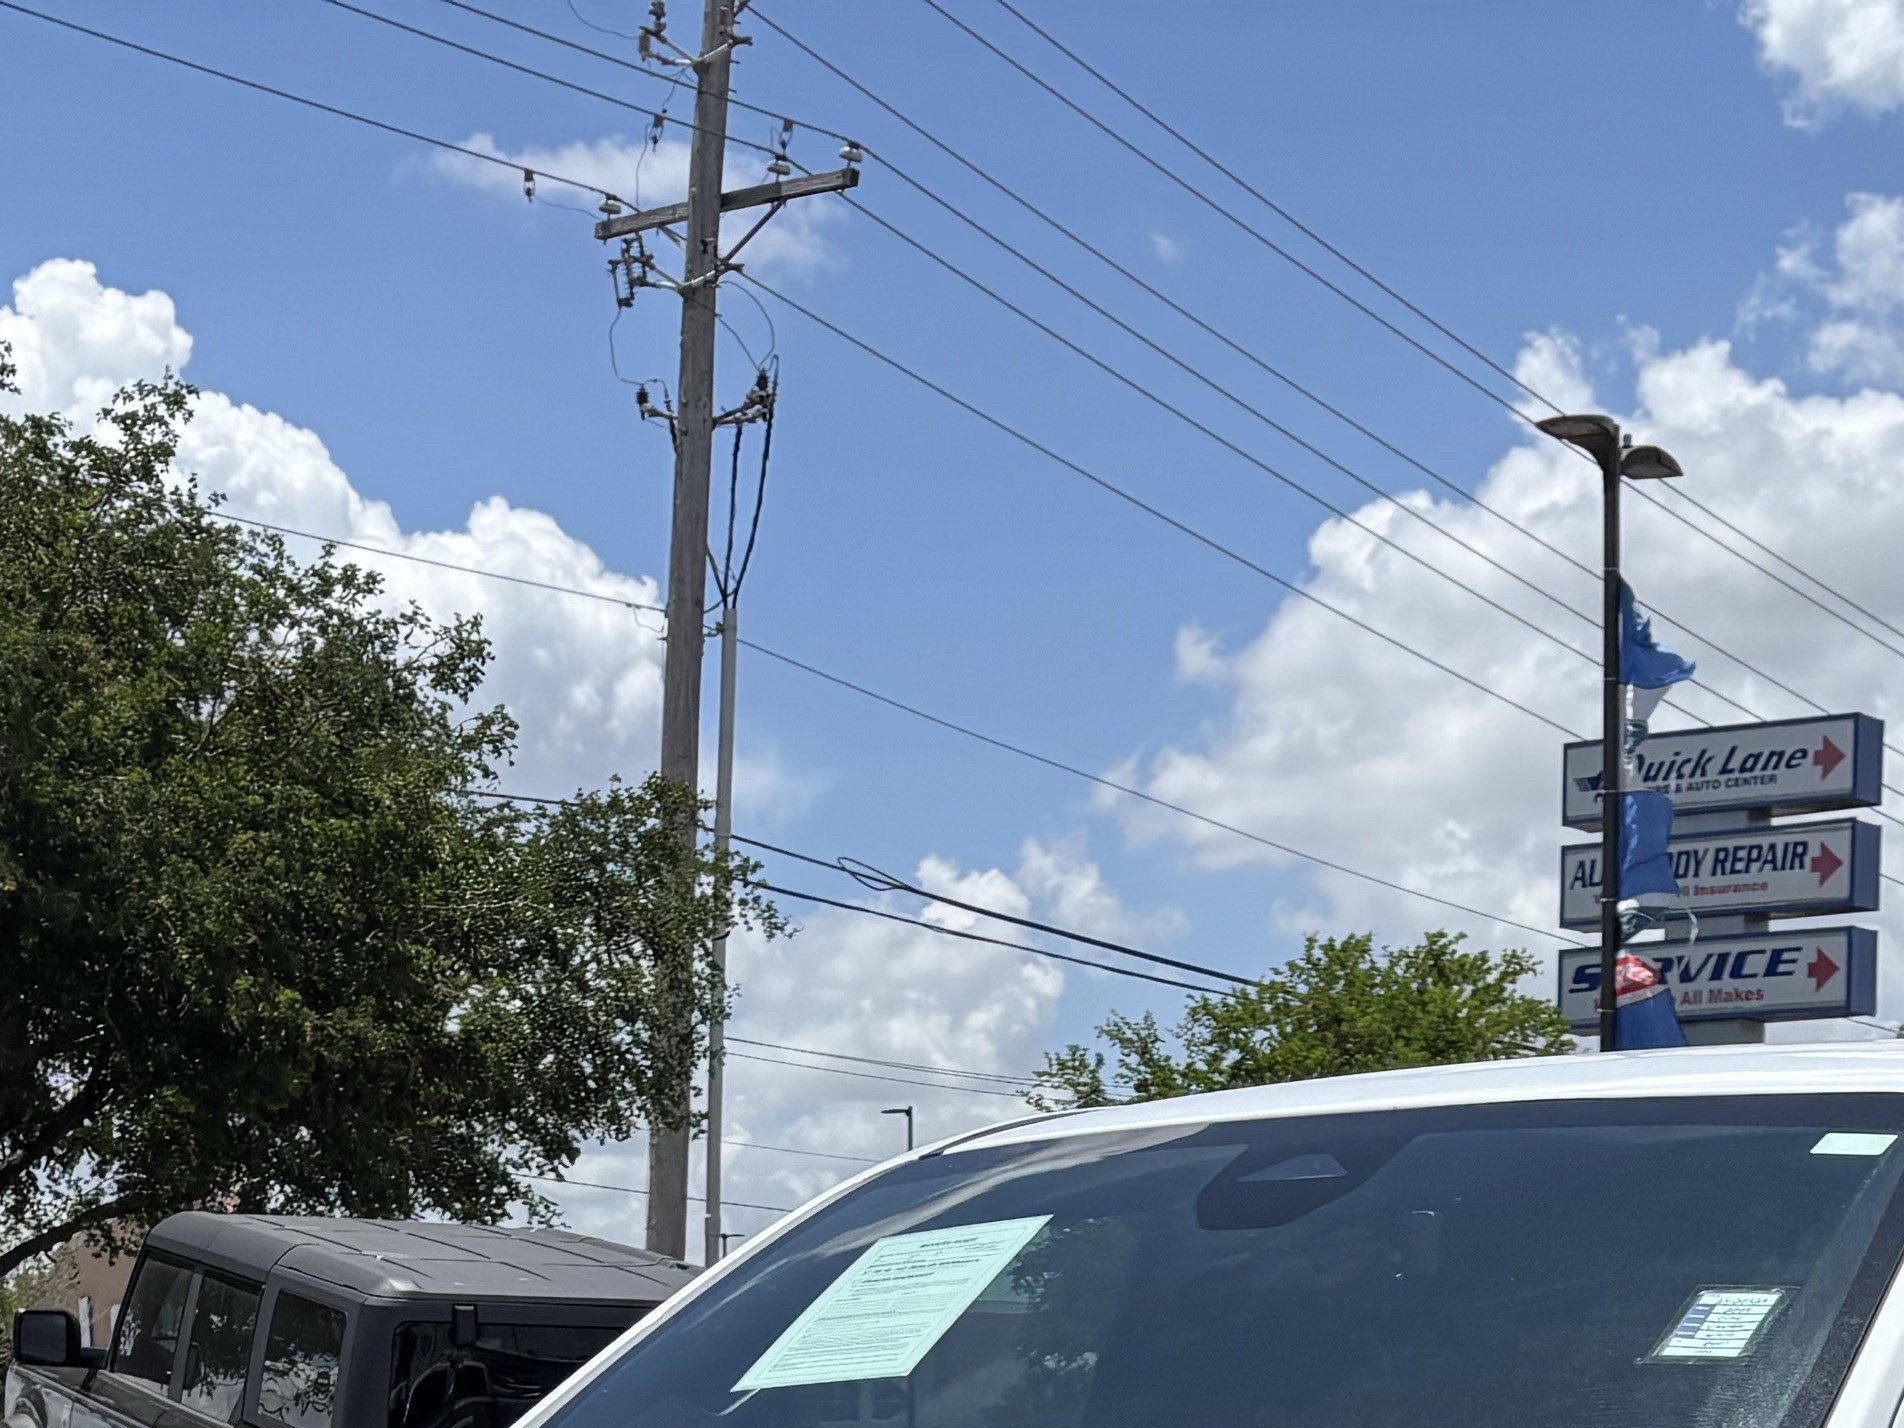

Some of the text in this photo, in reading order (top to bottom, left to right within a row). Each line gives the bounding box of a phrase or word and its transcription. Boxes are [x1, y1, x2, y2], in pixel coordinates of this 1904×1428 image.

[1637, 745, 1808, 782] uick Lane
[1686, 779, 1721, 791] AUTO
[1724, 774, 1777, 788] CENTER
[1711, 841, 1808, 877] REPAIR
[1694, 880, 1769, 896] Insurance
[1568, 946, 1803, 994] SRVICE
[1709, 987, 1764, 1002] Makes
